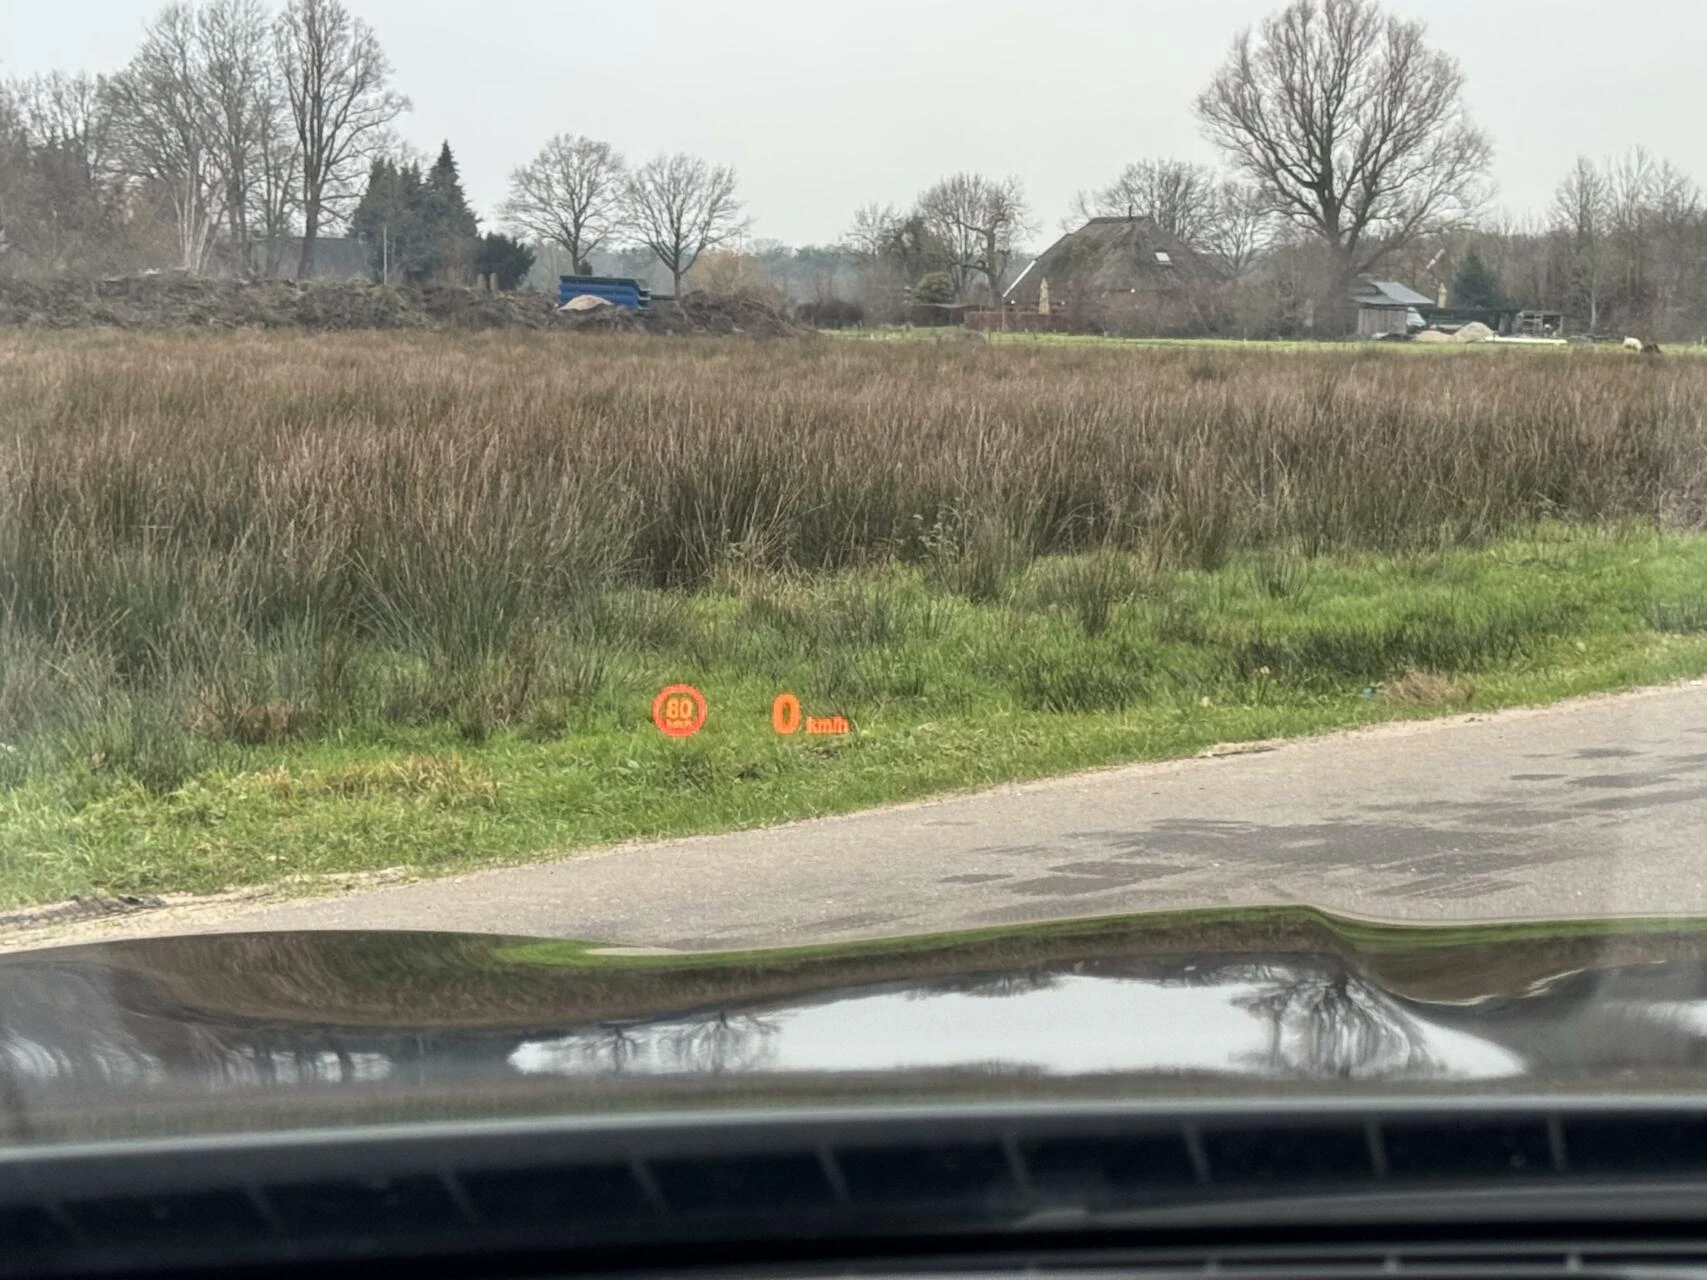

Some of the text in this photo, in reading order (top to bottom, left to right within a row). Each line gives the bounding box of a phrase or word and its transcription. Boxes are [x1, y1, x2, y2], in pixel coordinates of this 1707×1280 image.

[666, 697, 692, 718] 80
[773, 692, 849, 733] 0 km/h
